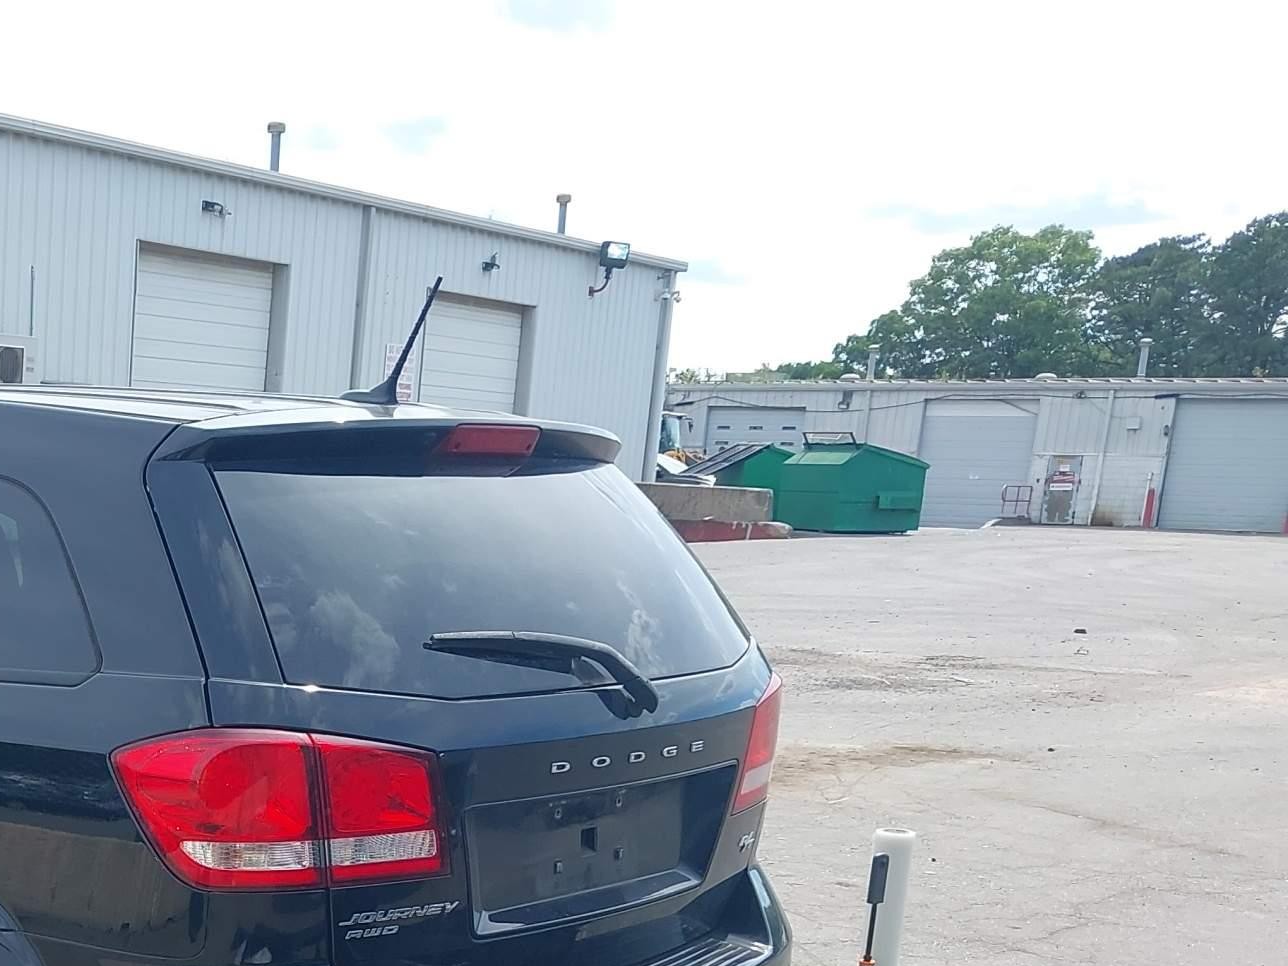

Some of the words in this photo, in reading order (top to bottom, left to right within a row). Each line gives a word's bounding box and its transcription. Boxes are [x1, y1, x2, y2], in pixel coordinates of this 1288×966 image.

[550, 739, 705, 773] DODGE
[338, 900, 460, 927] JOURNEY
[344, 925, 399, 940] AWD
